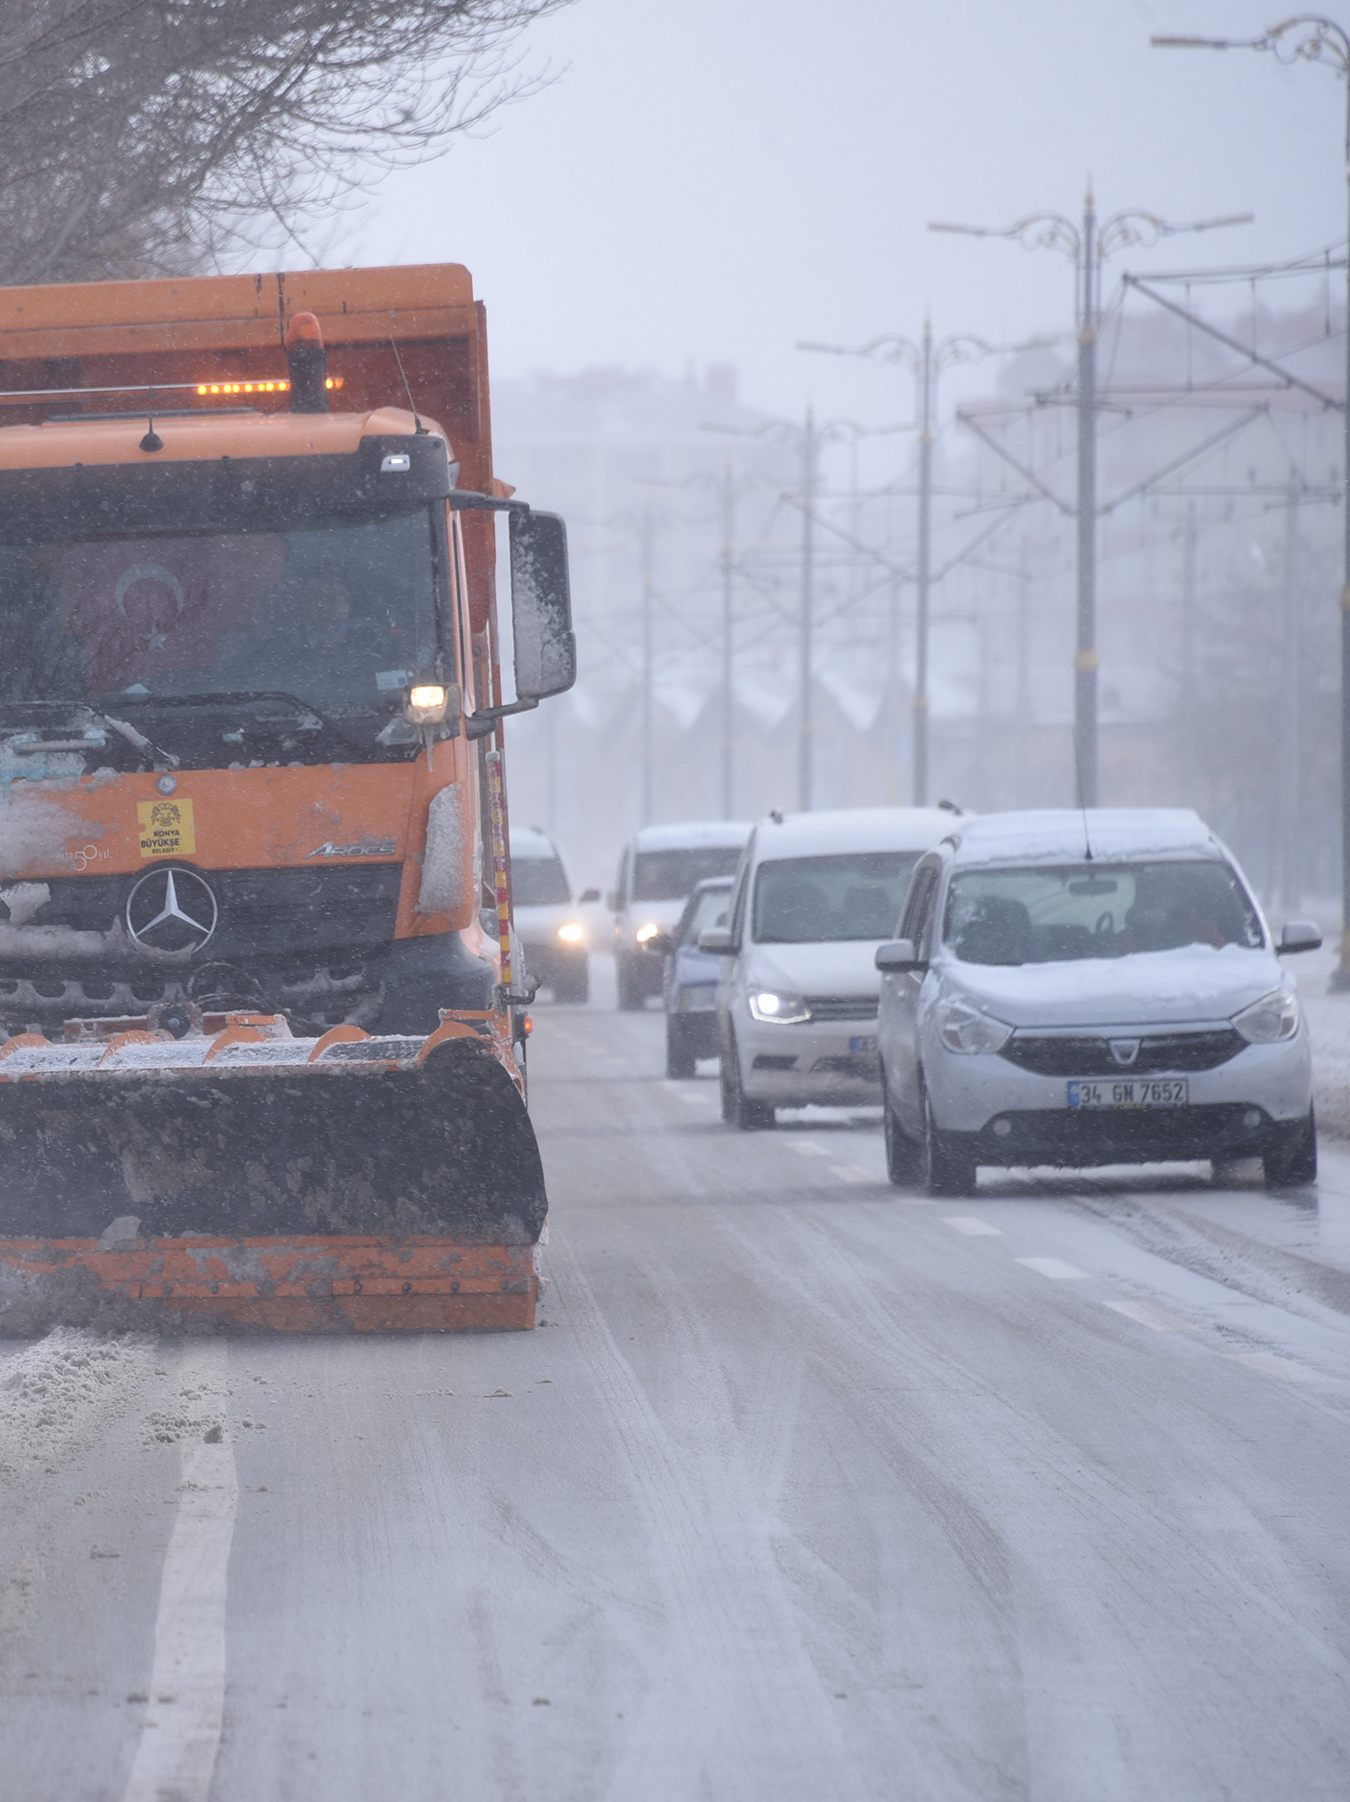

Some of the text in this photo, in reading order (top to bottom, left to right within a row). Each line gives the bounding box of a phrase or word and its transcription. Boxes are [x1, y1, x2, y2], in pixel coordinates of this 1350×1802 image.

[153, 829, 180, 837] KONYA
[140, 837, 181, 848] BÜYÜKŞE
[1081, 1082, 1183, 1103] 34 GN 7652
